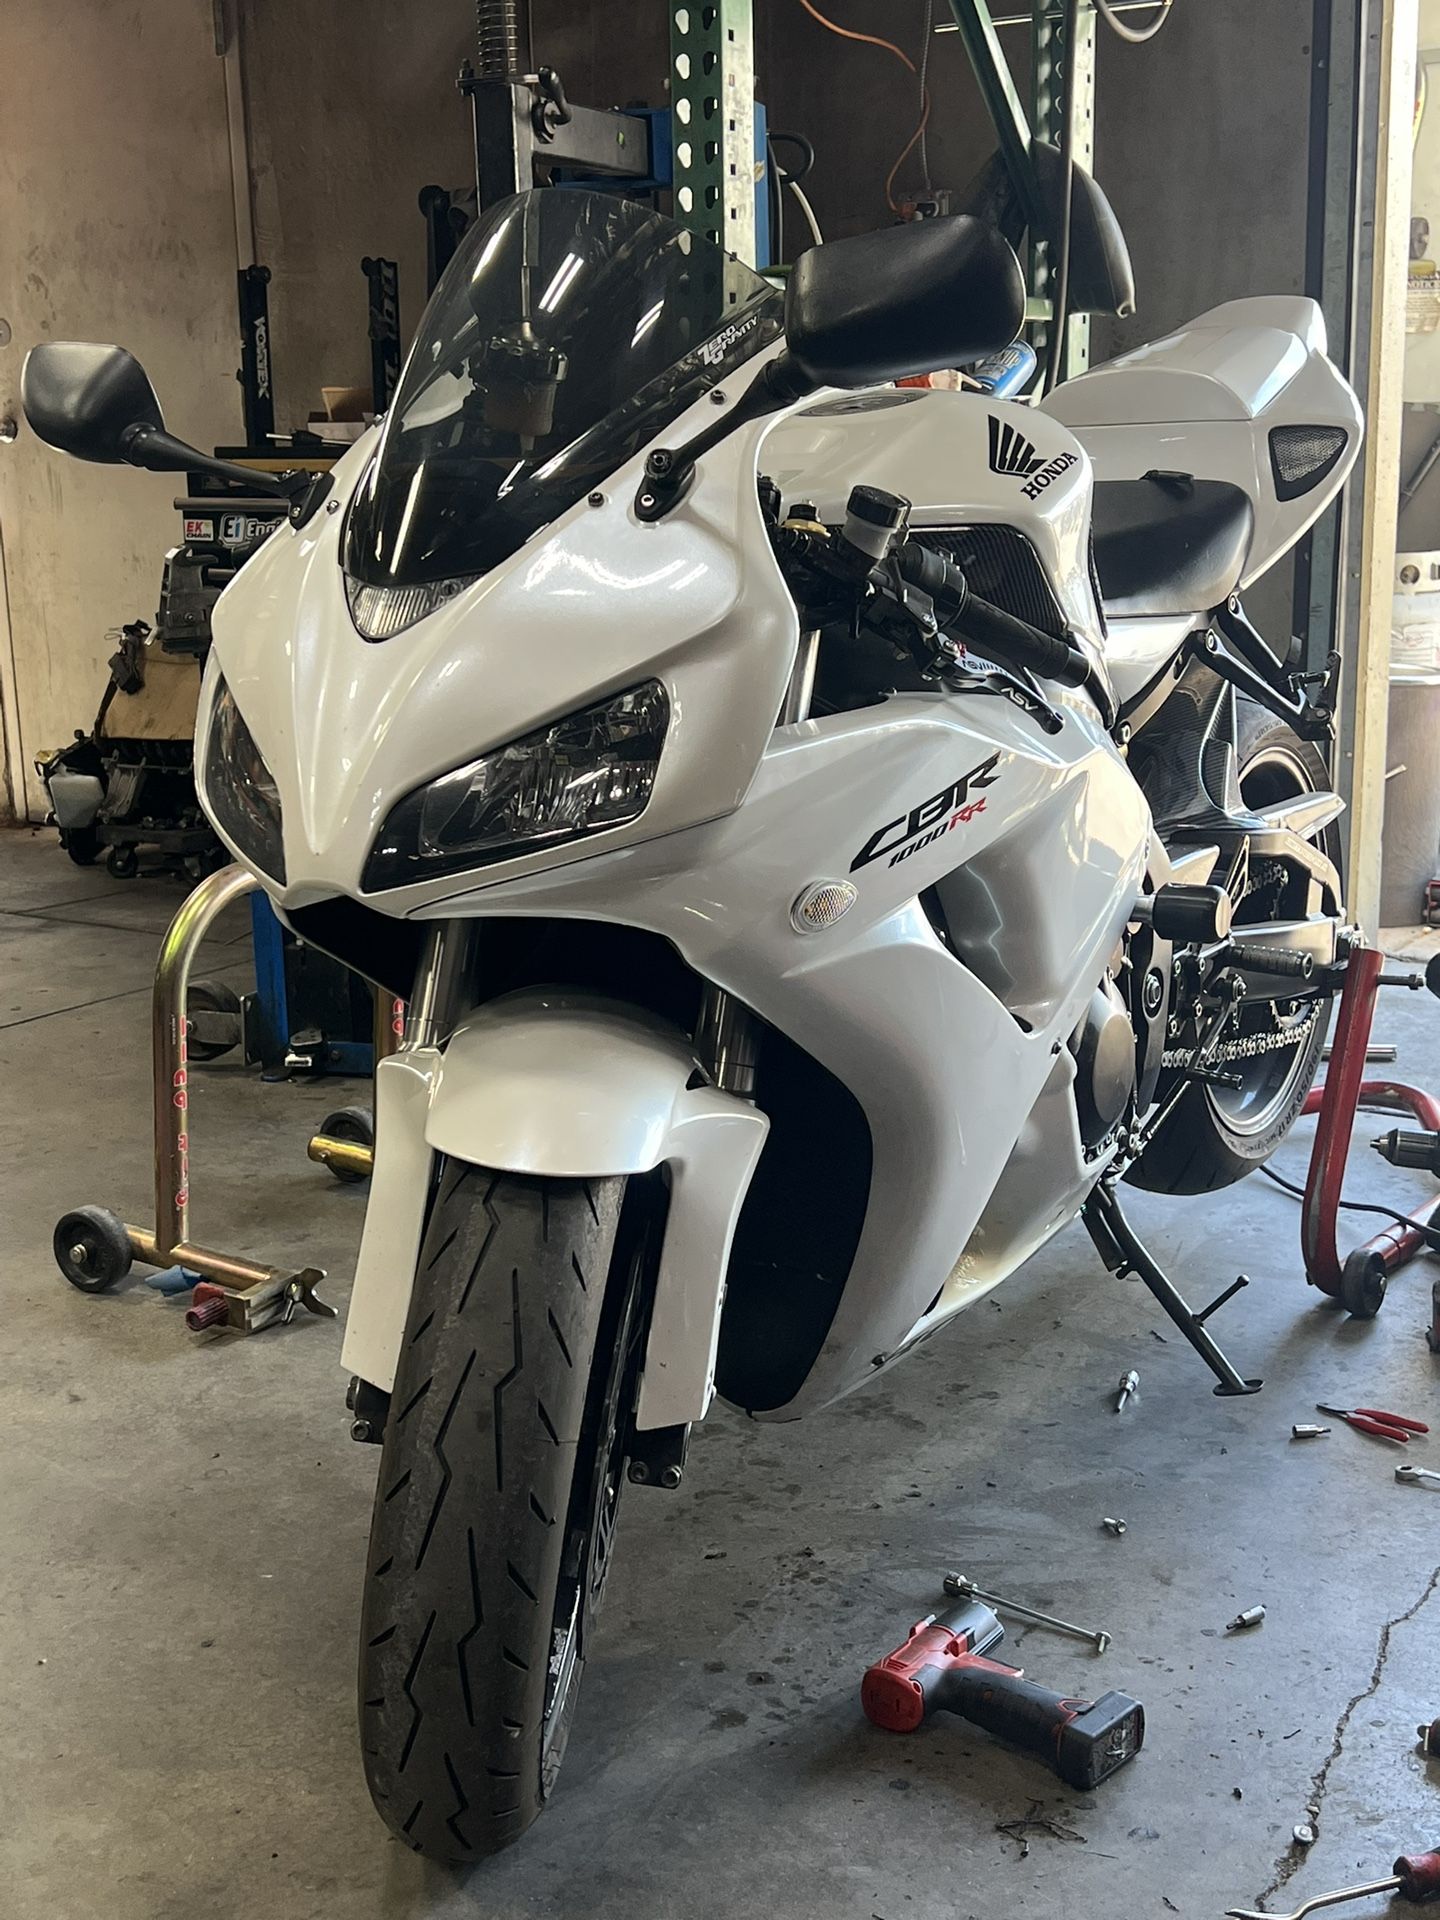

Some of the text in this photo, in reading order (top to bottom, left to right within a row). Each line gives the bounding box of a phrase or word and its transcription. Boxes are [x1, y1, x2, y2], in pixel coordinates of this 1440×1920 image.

[253, 316, 271, 399] VORTEX
[697, 325, 737, 366] ZERO
[711, 316, 758, 365] GRAVITY
[1020, 452, 1079, 500] HONDA
[186, 521, 204, 533] EK
[1001, 687, 1039, 711] ASV
[849, 750, 1001, 873] CBR
[888, 797, 987, 869] 1000RR
